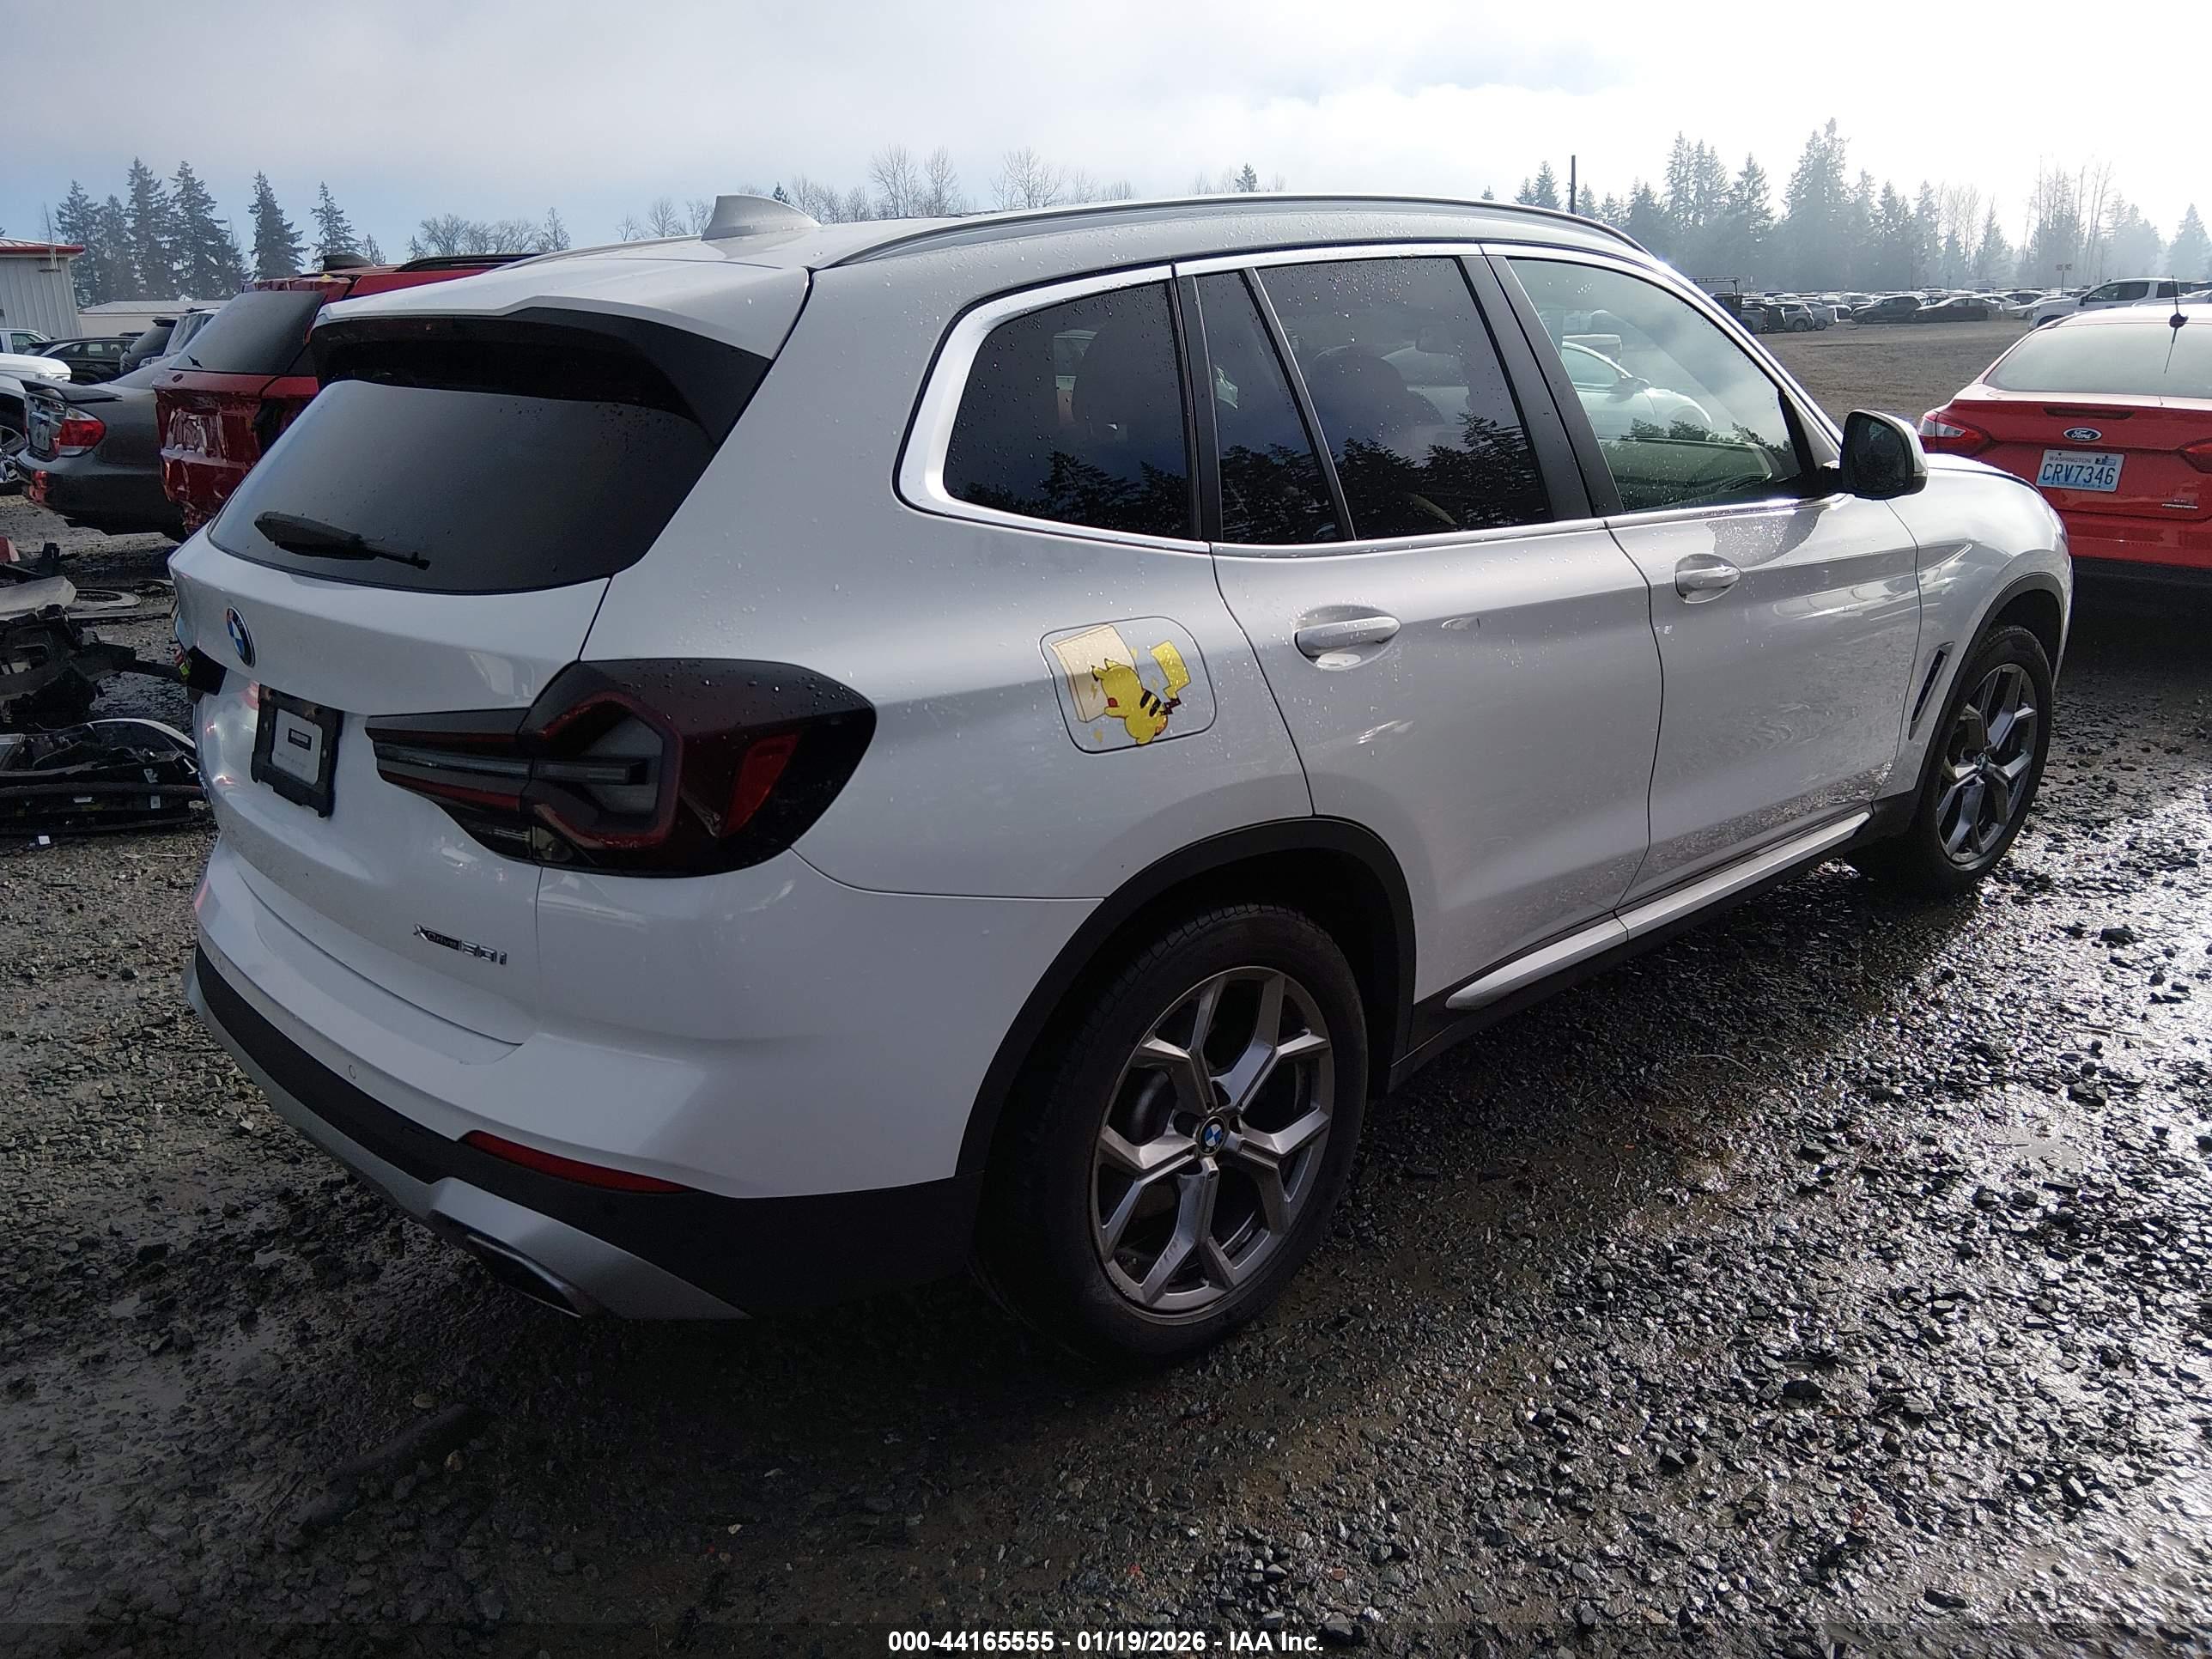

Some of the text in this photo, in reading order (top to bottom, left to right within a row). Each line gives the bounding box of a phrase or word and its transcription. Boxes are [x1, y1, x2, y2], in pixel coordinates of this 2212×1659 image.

[2070, 428, 2094, 439] Ford
[2048, 455, 2092, 464] WASHINGTON
[2042, 463, 2116, 485] CRV7346
